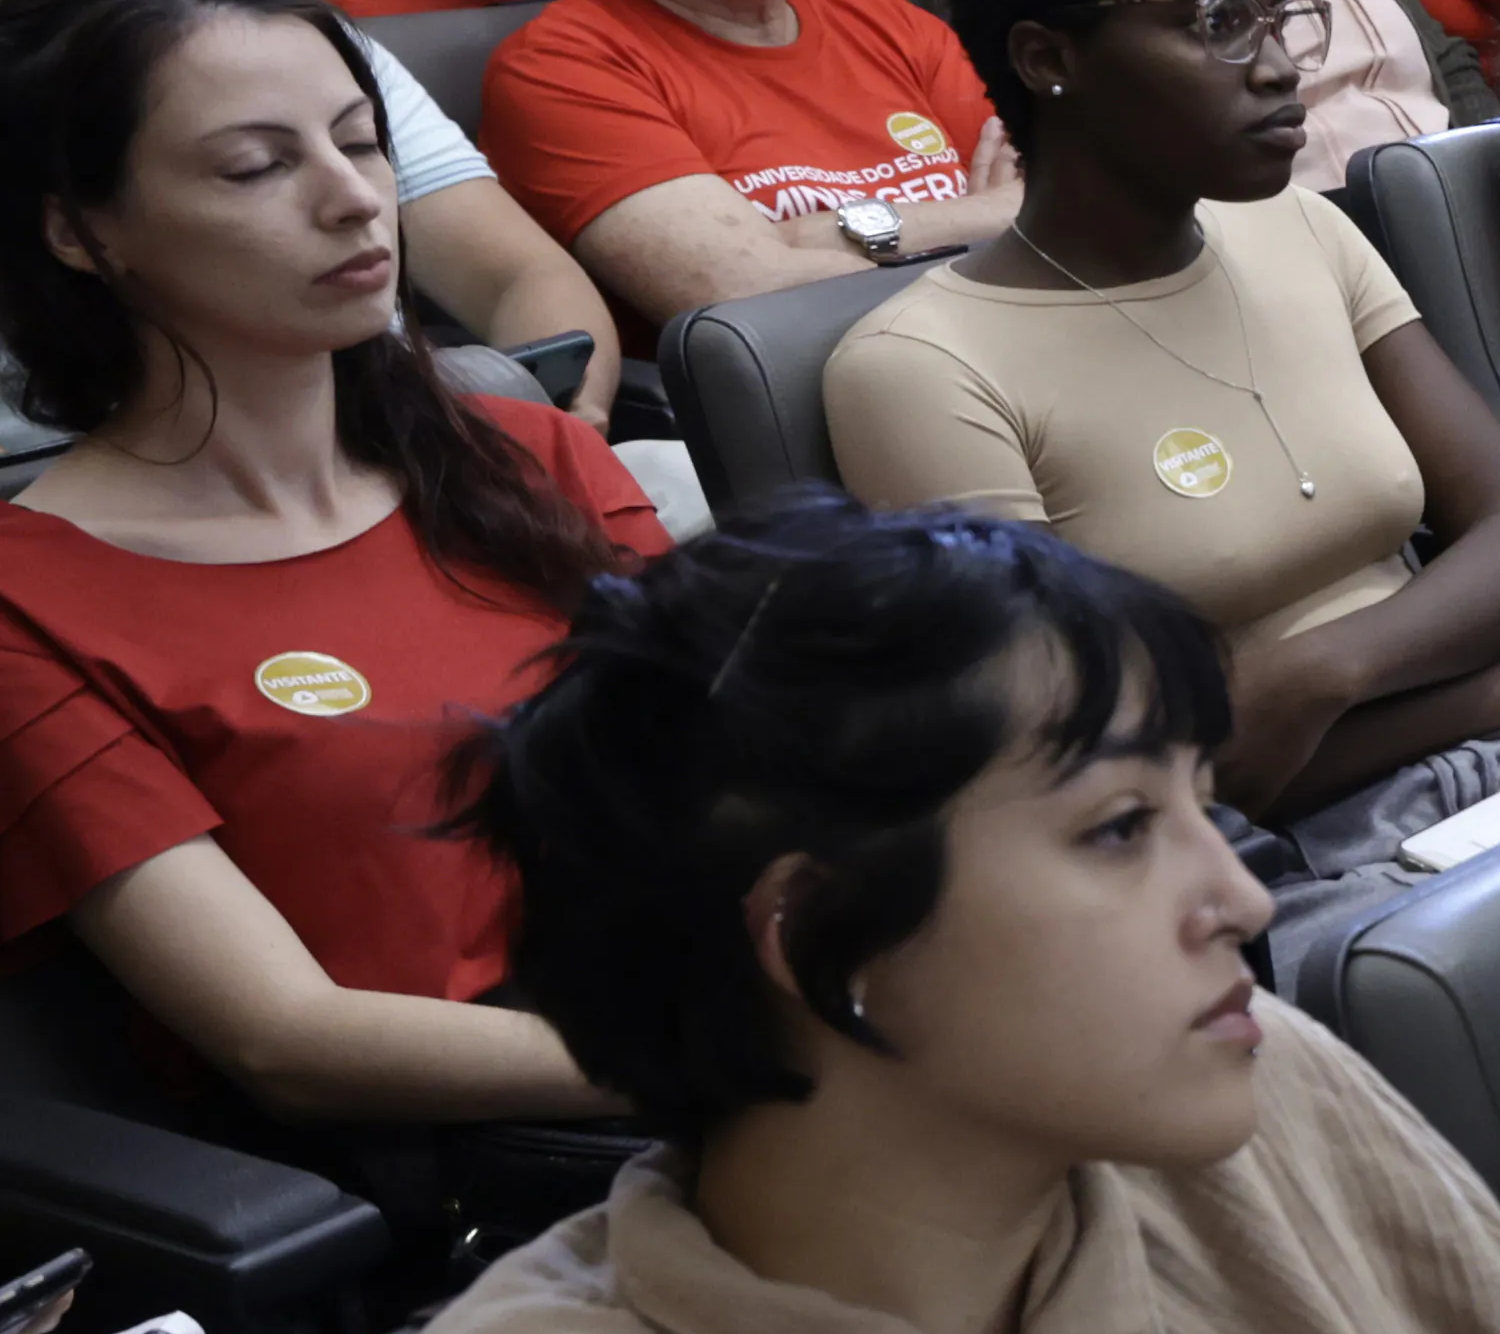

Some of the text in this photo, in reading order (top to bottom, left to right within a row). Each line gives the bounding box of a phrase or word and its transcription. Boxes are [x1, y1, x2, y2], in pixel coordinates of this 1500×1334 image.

[733, 165, 864, 194] UNIVERSIDADE
[862, 162, 895, 183] DO
[262, 669, 353, 689] VISITANTE
